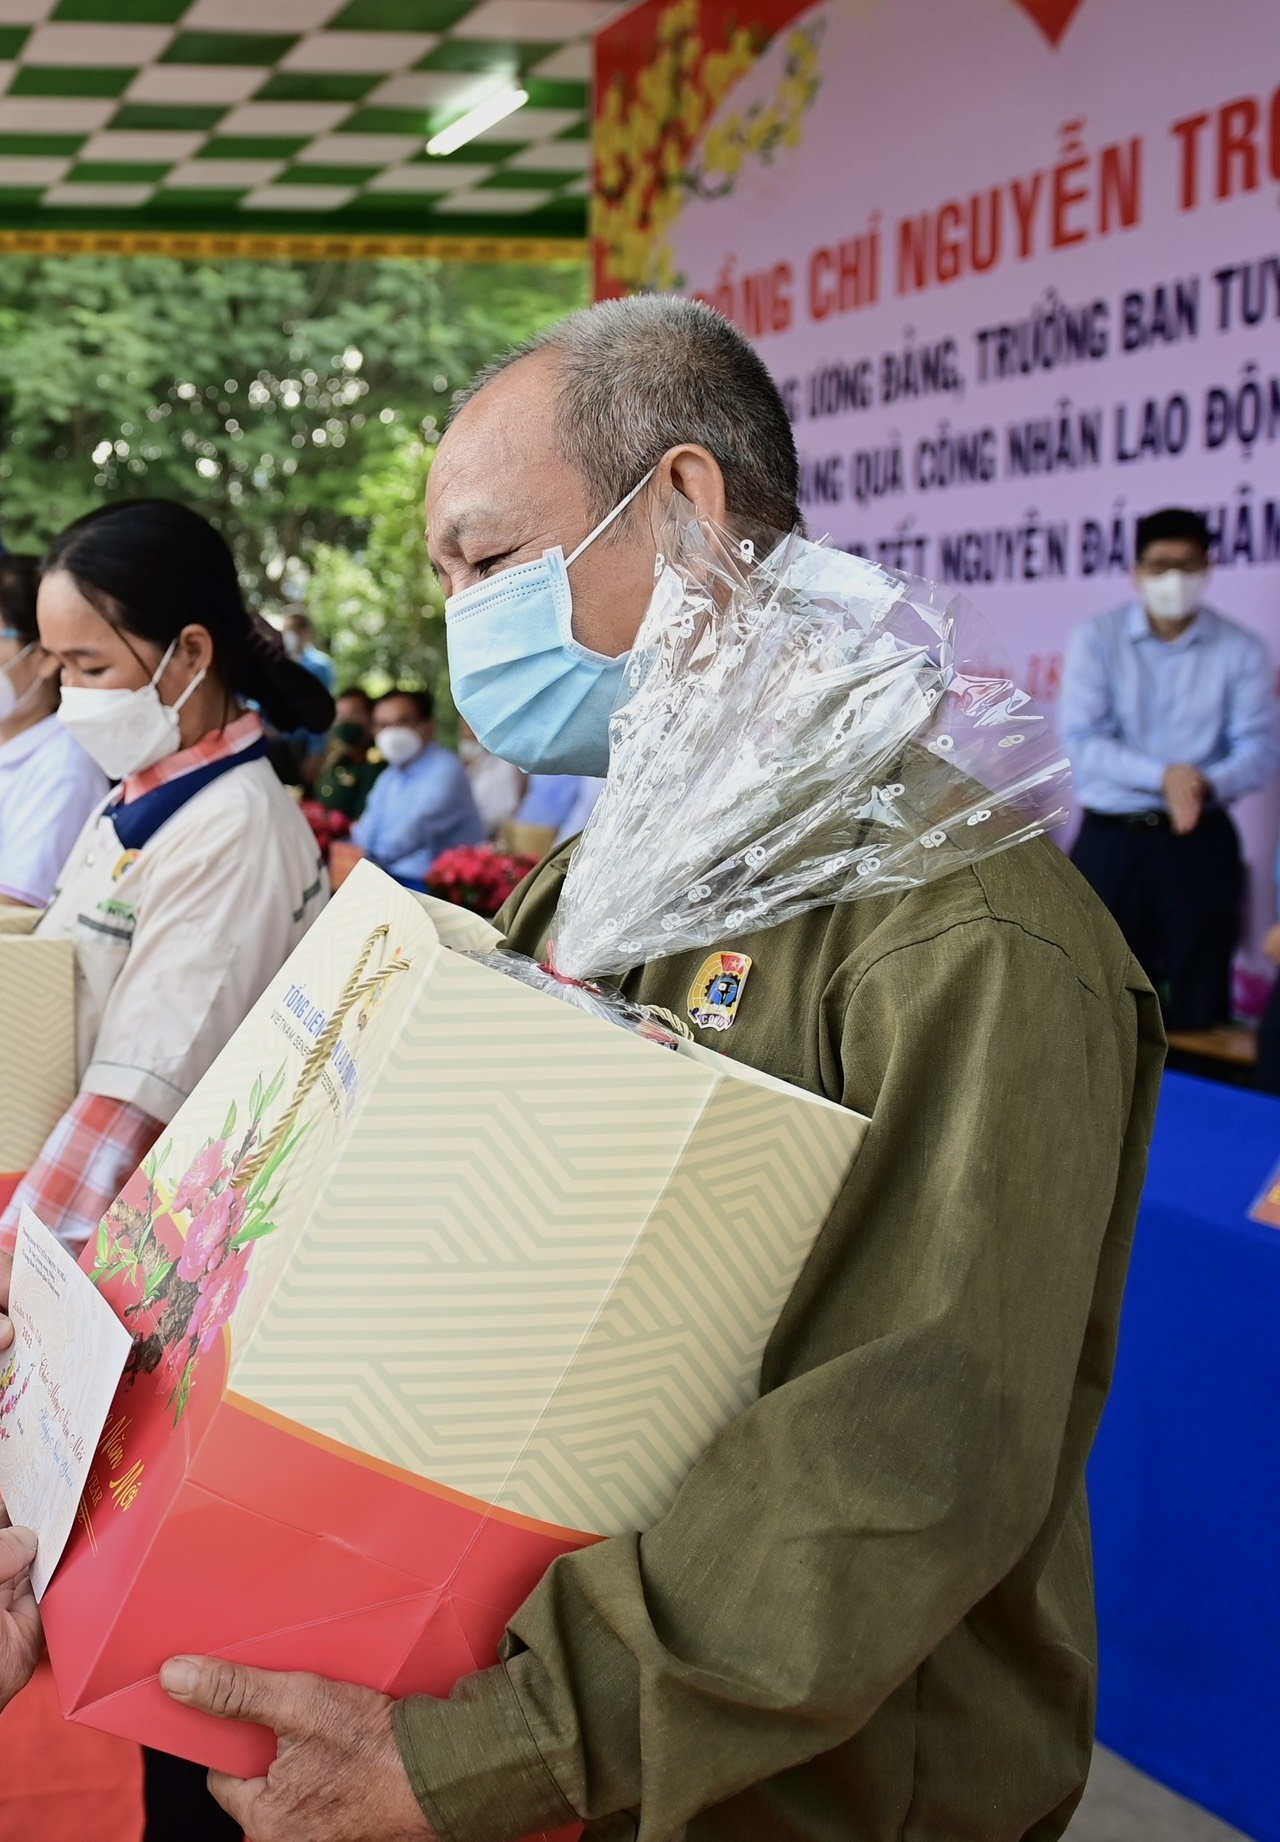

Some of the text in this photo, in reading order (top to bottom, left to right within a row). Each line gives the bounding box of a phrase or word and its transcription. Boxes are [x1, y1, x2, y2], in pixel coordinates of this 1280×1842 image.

[694, 253, 792, 338] ỒNG
[810, 210, 880, 322] CHÍ
[897, 117, 1142, 297] NGUYỄN
[1122, 280, 1200, 351] BAN
[917, 418, 996, 489] CÔNG
[1007, 399, 1102, 478] NHÂN
[1116, 393, 1189, 462] LAO
[1082, 498, 1137, 574] ĐÁ
[269, 1009, 296, 1041] VIETNAM
[282, 983, 310, 1019] TỔNG
[89, 1469, 104, 1508] YEAR
[108, 1457, 144, 1513] Mới
